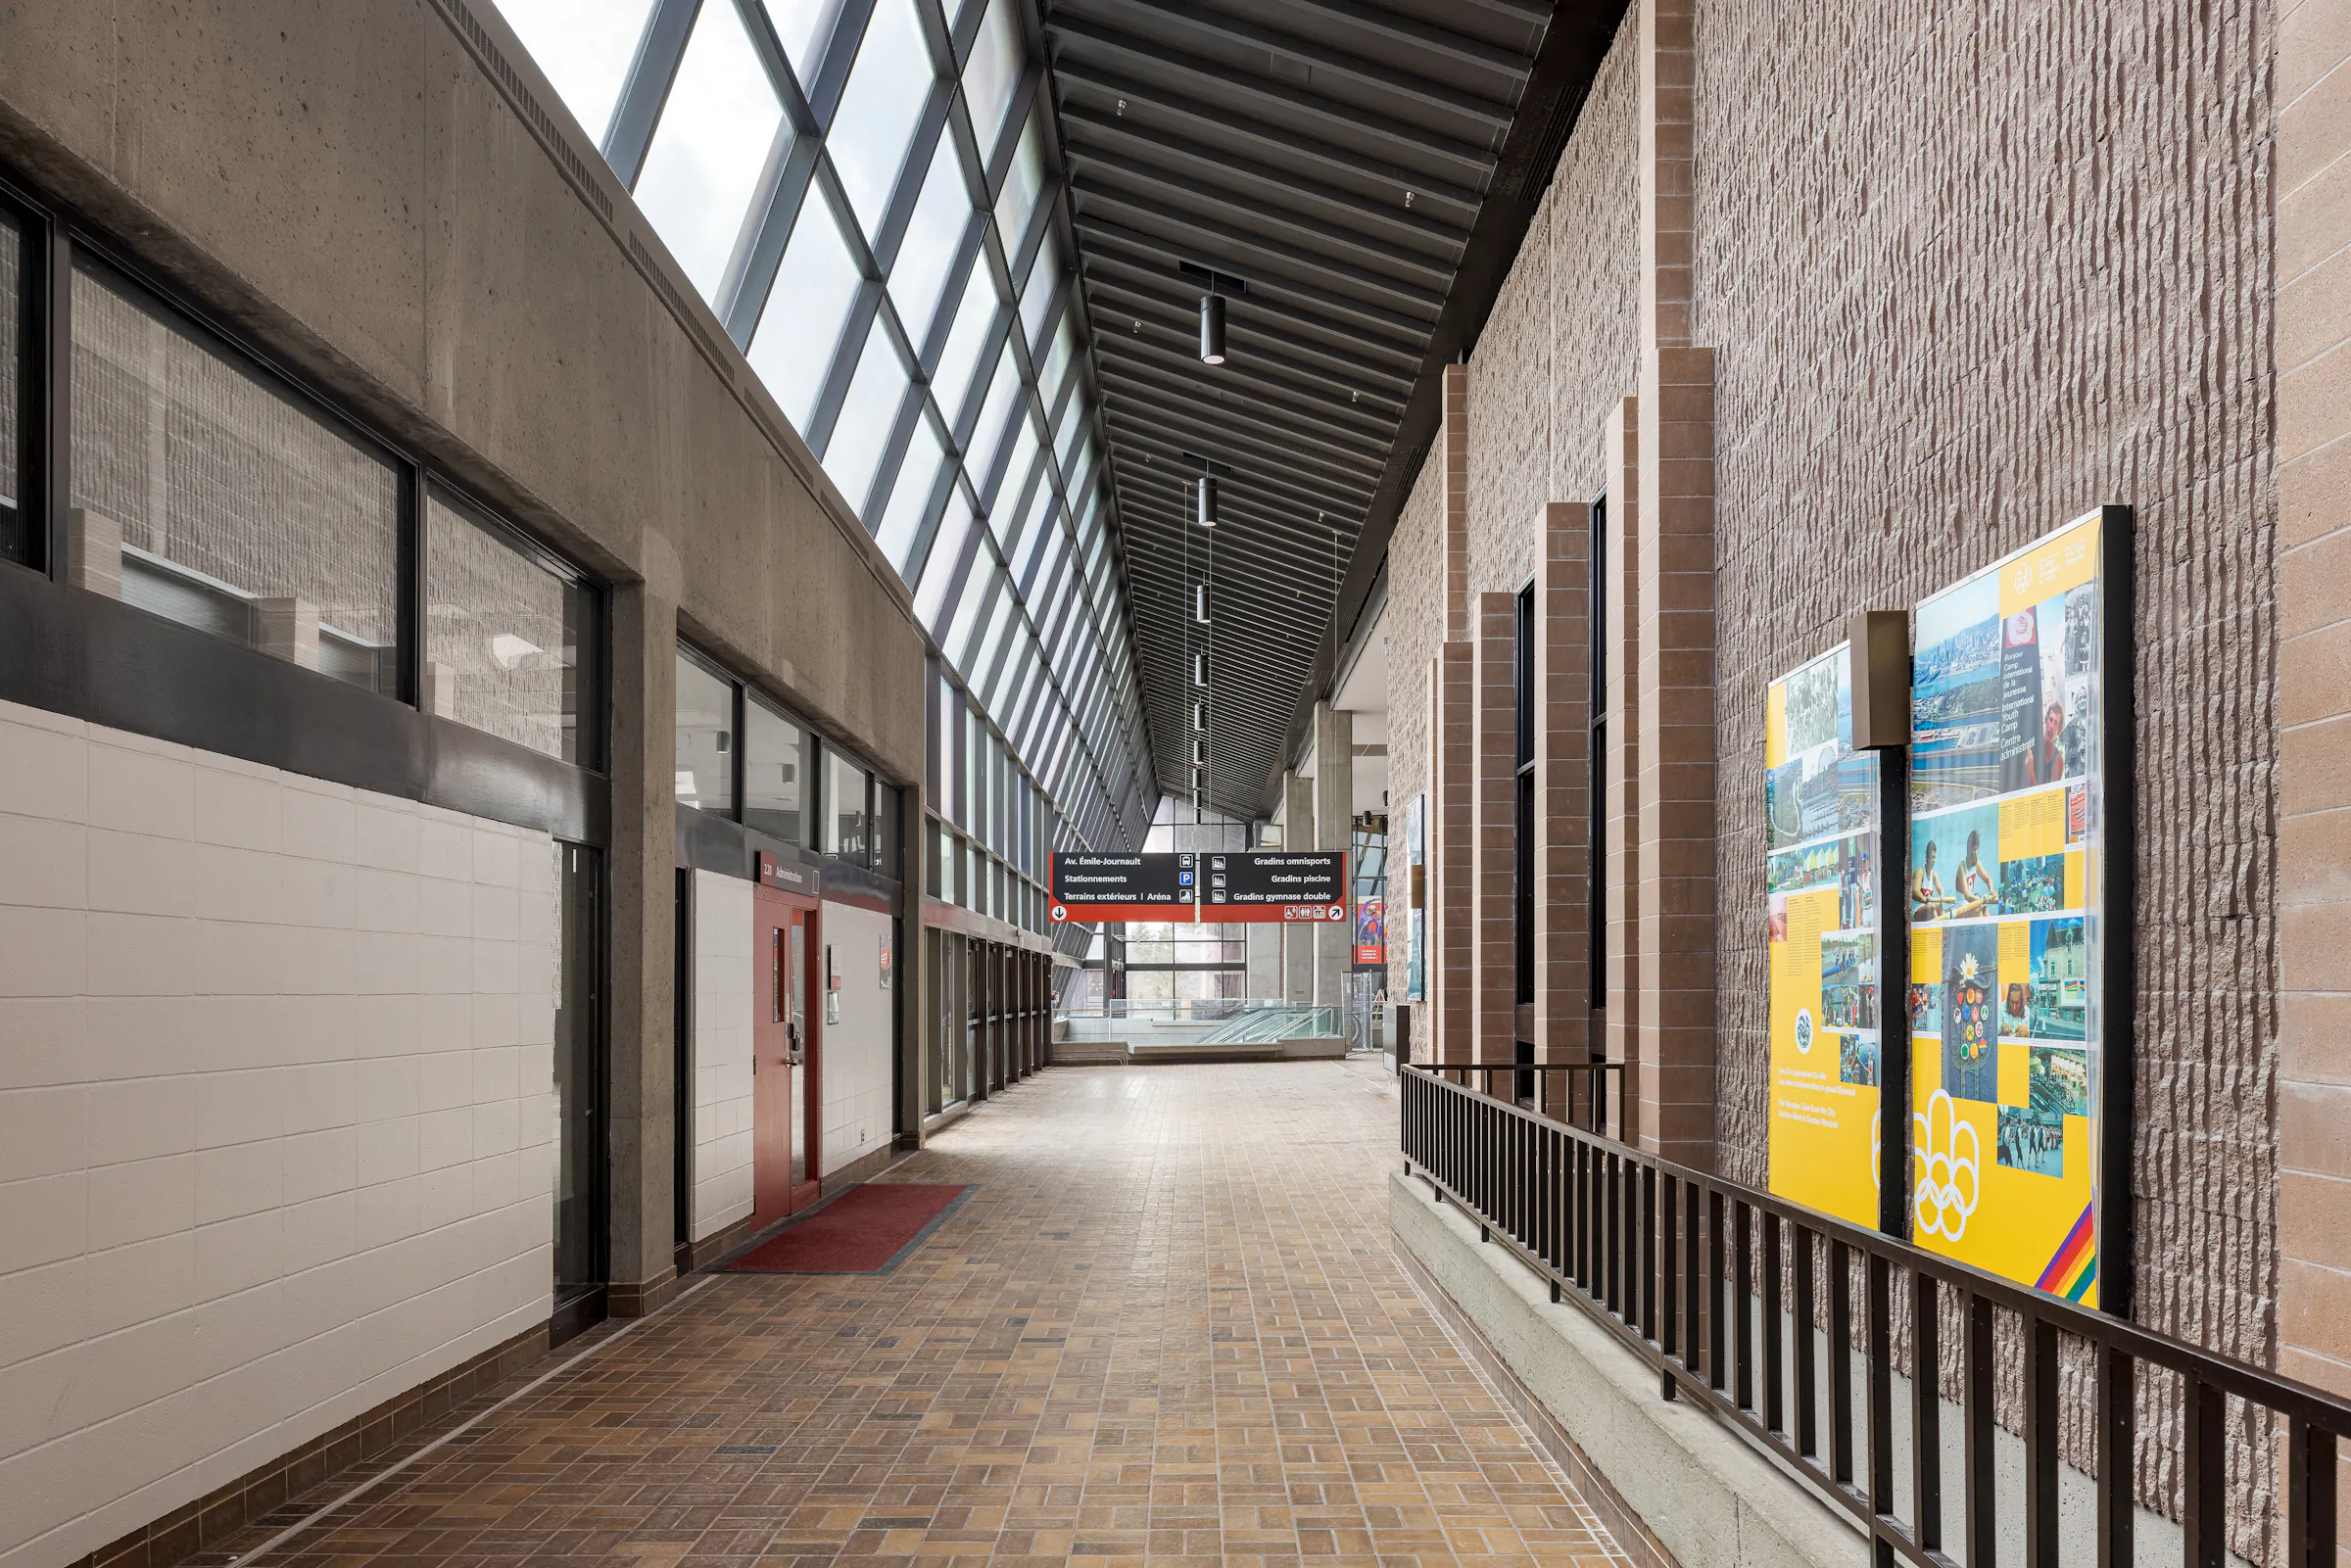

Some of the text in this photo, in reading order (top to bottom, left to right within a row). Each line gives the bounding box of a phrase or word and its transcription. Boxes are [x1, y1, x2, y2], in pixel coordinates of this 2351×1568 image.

[2003, 662, 2018, 672] Camp
[2003, 665, 2033, 680] international
[2002, 678, 2016, 689] de la
[2002, 686, 2027, 701] jeunesse
[2002, 694, 2034, 712] International
[2001, 708, 2019, 722] Youth
[2000, 721, 2018, 734] Camp
[2000, 735, 2021, 748] Centre
[1064, 855, 1141, 866] Av. Émile-Journault
[1254, 857, 1331, 867] Gradins omnisports
[776, 866, 802, 883] Administration
[1064, 875, 1128, 883] Stationnements
[1271, 875, 1331, 884] Gradins piscine
[1064, 892, 1095, 901] Terrains
[1096, 892, 1137, 901] extérieurs
[1146, 892, 1172, 901] Aréna
[1233, 892, 1331, 903] Gradins gymnase double
